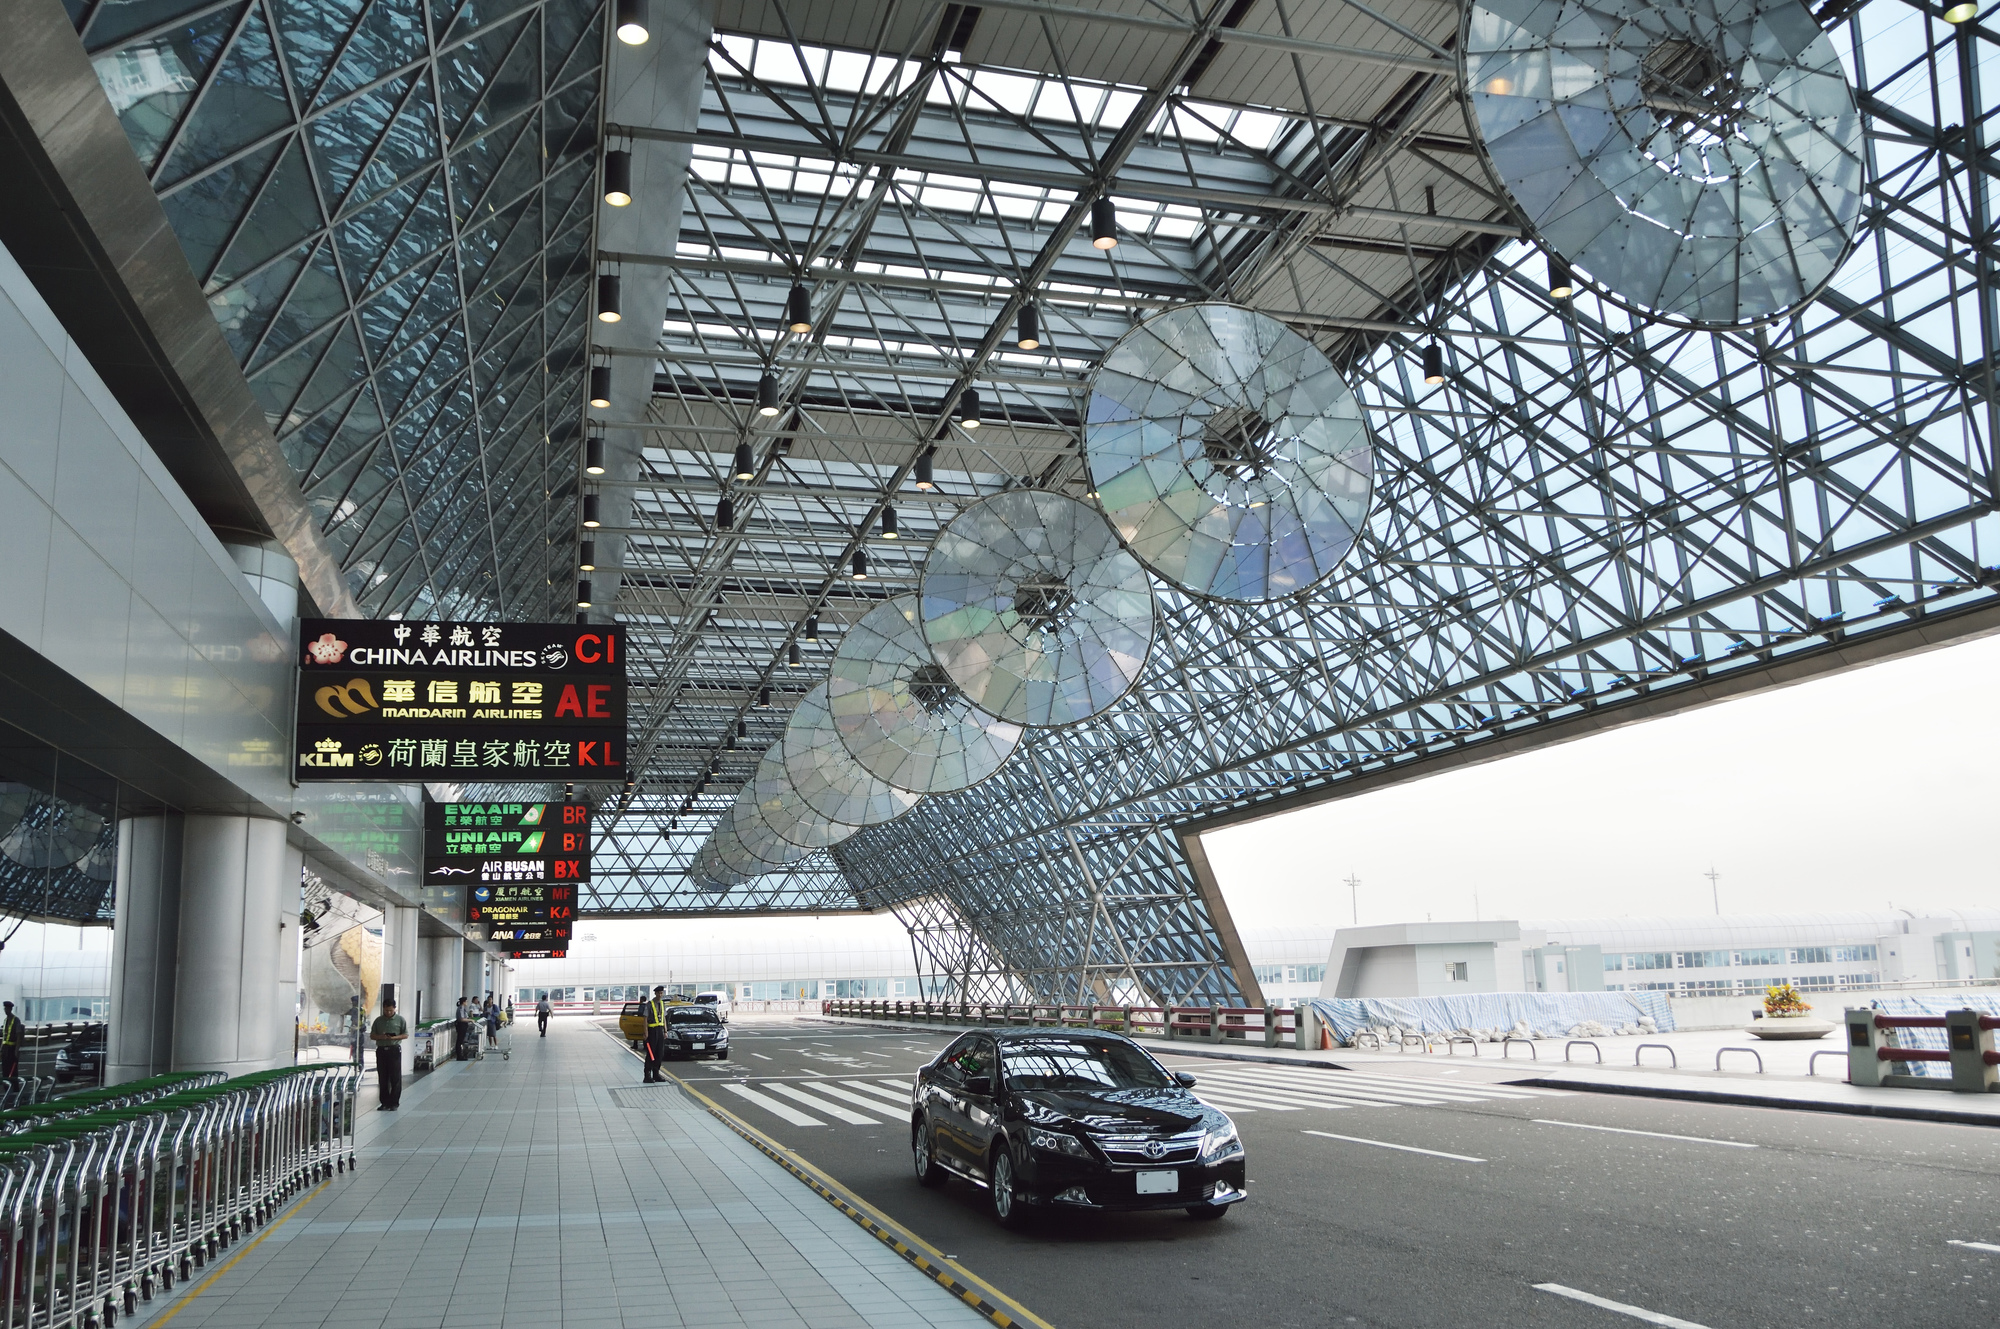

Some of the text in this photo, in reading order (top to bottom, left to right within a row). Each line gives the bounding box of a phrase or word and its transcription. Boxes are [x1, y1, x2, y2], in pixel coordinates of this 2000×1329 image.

[393, 624, 502, 647] 中華航空
[574, 633, 615, 663] CI
[350, 648, 536, 668] CHINA AIRLINES
[382, 679, 543, 704] 華信航空
[554, 684, 611, 718] AE
[382, 707, 543, 720] MANDARIN AIRLINES
[300, 753, 354, 767] KLM
[387, 738, 571, 768] 荷蘭皇家航空
[578, 741, 620, 767] KL
[444, 804, 523, 815] EVA AIR
[563, 806, 587, 824] BR
[444, 816, 503, 826] 長榮航空
[446, 832, 522, 843] UNI AIR
[563, 833, 585, 852] B7
[446, 843, 502, 854] 立榮航空
[481, 860, 545, 872] AIR BUSAN
[554, 860, 580, 878] BX
[552, 888, 571, 900] MF
[550, 906, 571, 919] KA
[491, 930, 514, 940] ANA
[552, 950, 565, 958] HX
